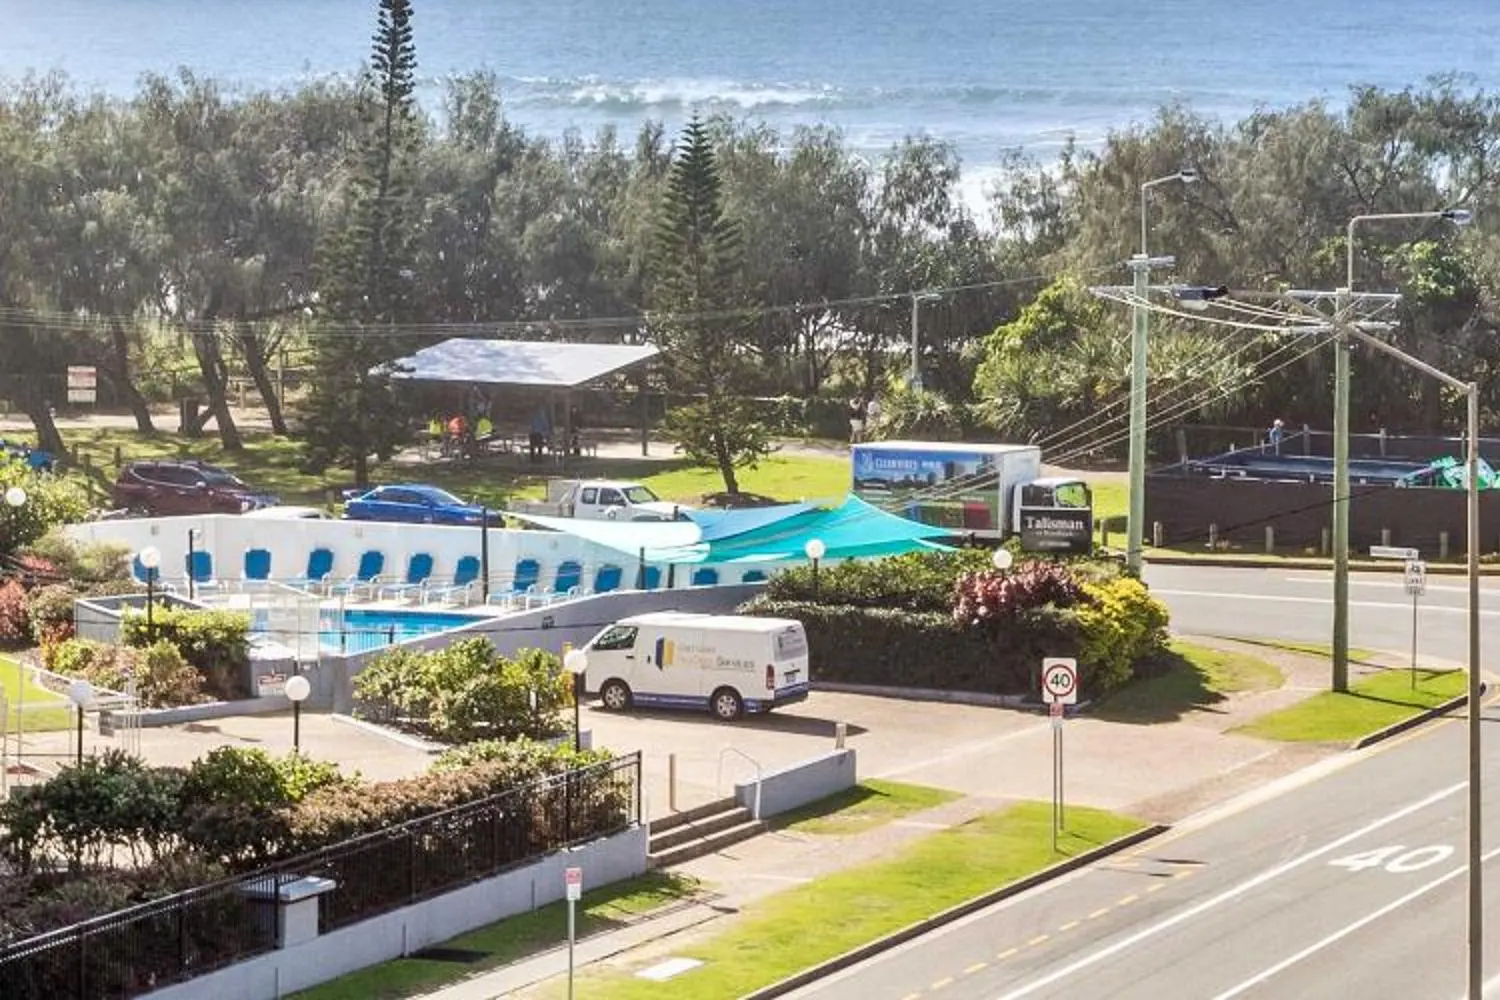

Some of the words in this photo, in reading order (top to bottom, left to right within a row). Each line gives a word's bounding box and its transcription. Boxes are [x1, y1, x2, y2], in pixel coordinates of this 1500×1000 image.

[1024, 516, 1083, 529] Talisman
[1050, 673, 1071, 688] 40
[1327, 845, 1454, 873] 40
